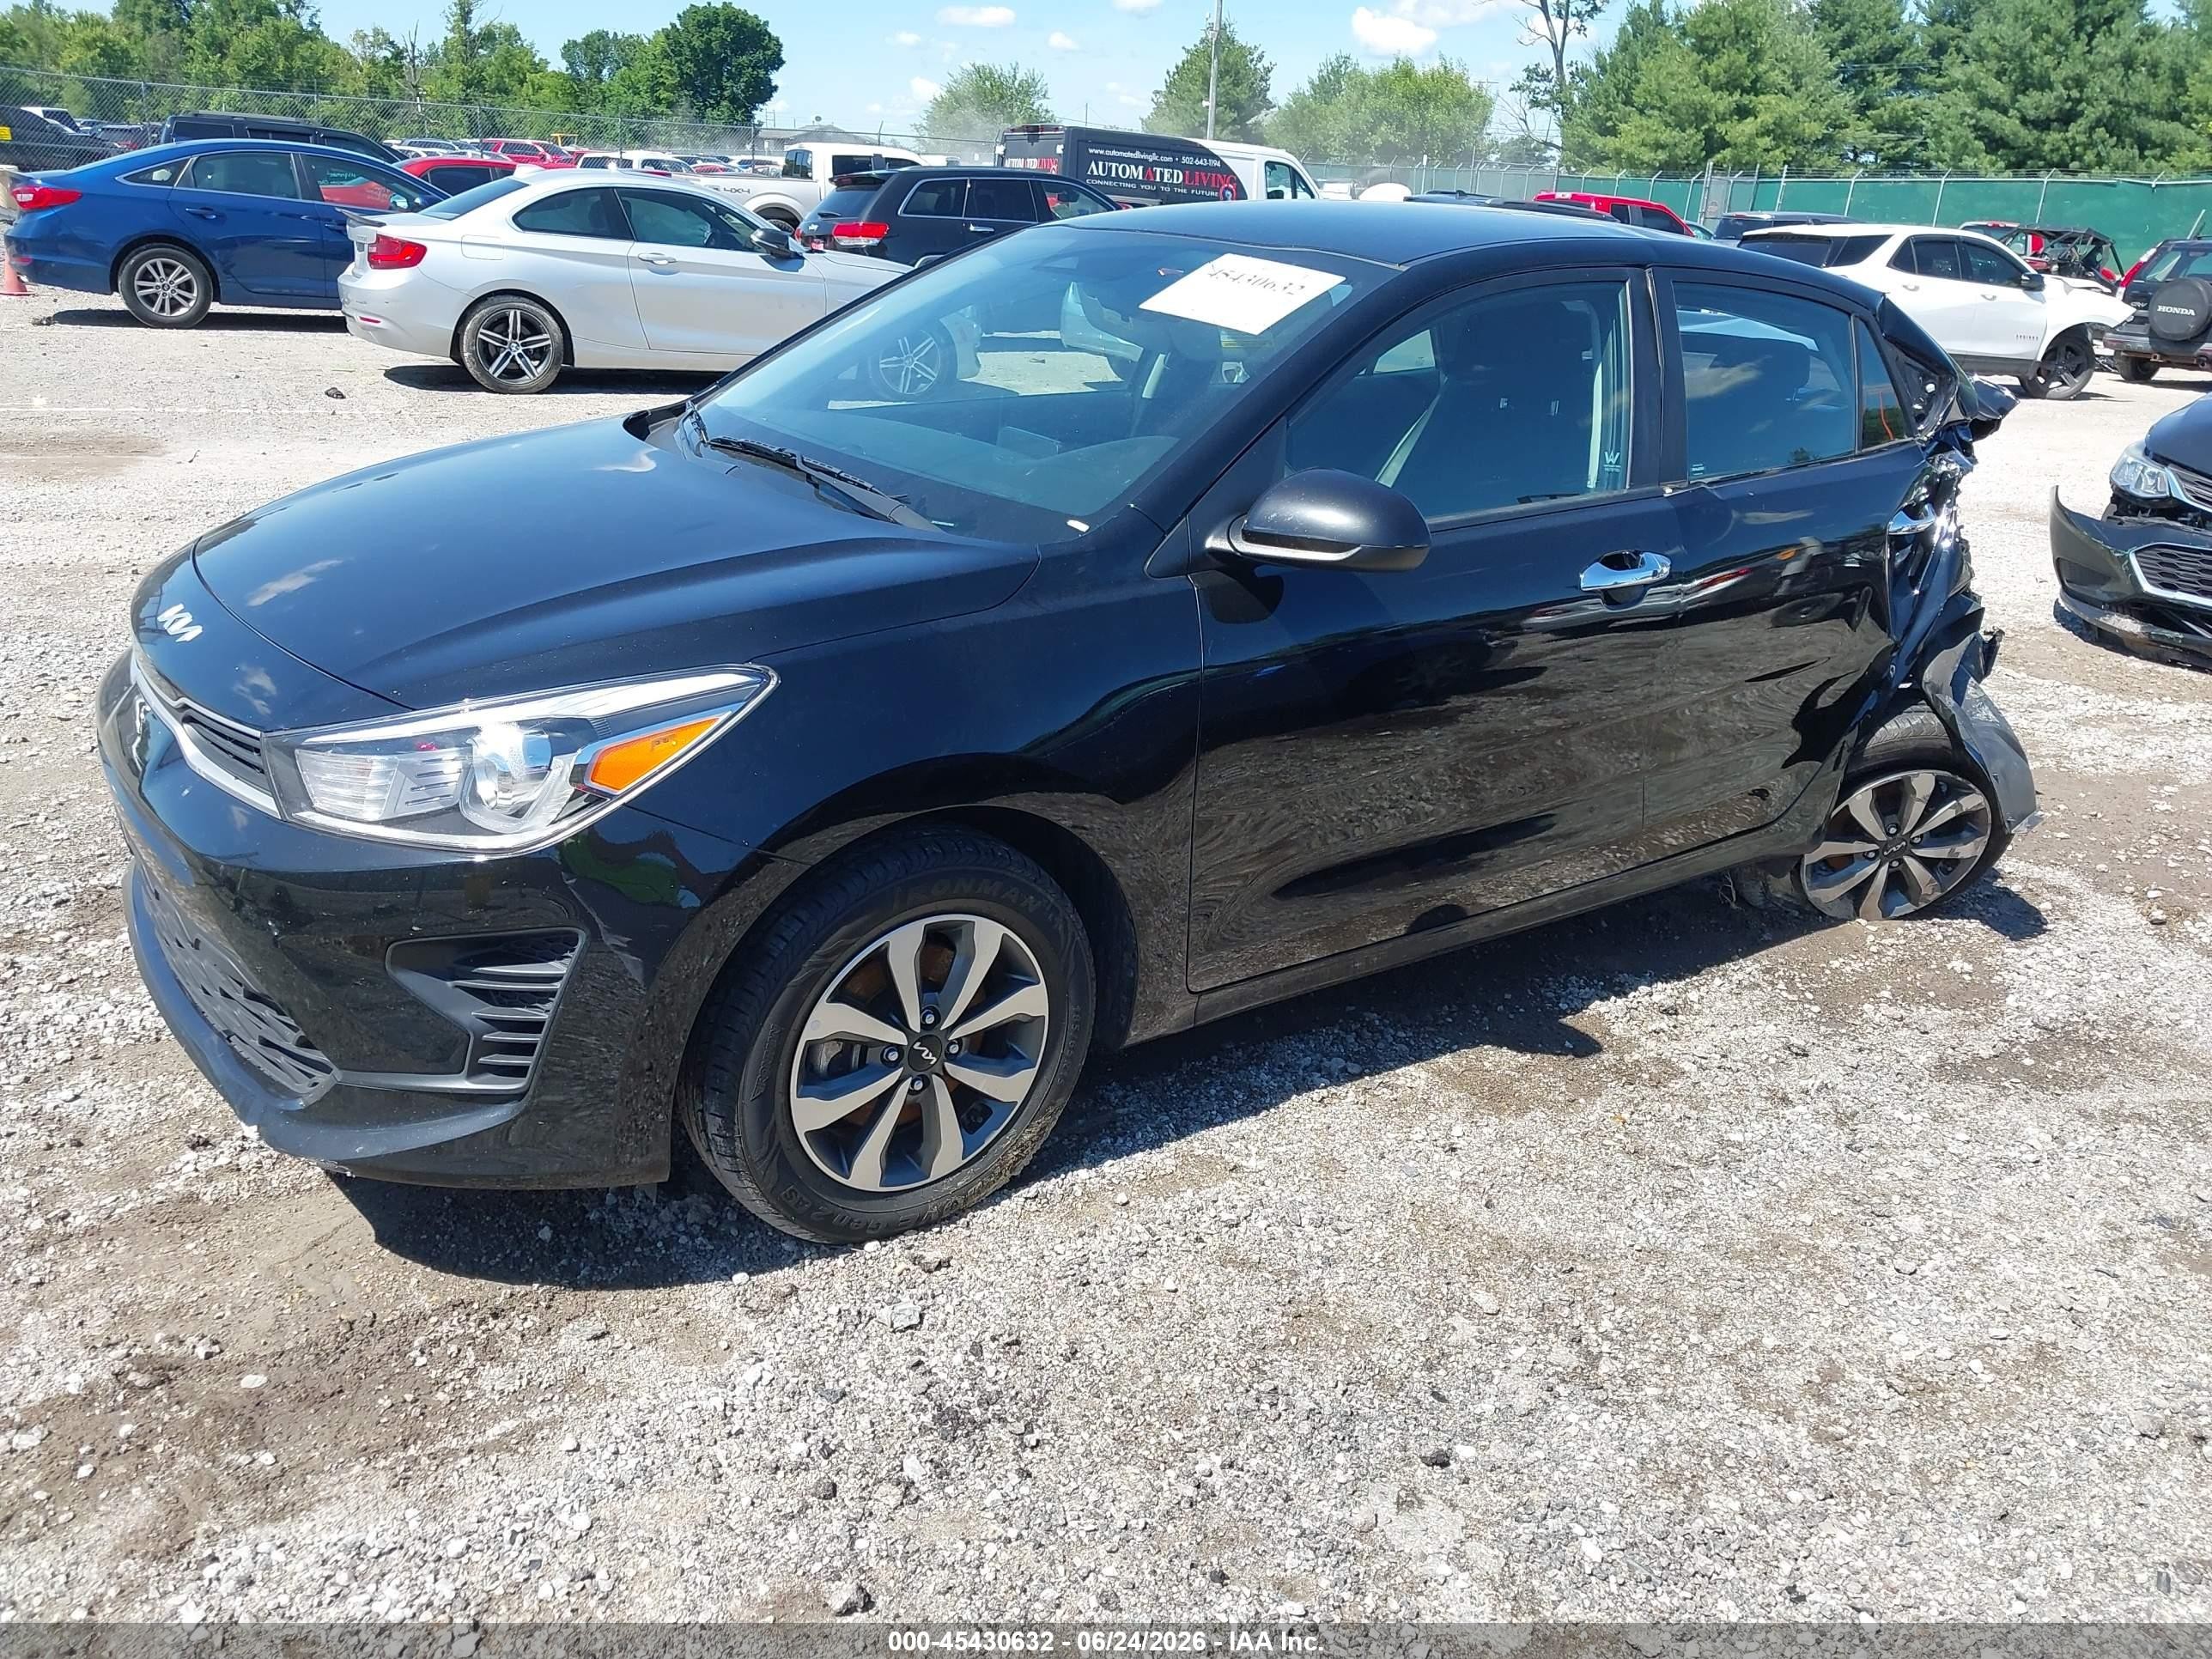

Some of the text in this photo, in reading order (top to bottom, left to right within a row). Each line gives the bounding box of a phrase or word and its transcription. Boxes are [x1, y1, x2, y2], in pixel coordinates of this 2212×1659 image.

[1088, 148, 1221, 167] www.automatedlivingllc.com 502-643-1194
[1086, 161, 1237, 188] AUTOMATED LIVING
[1085, 179, 1137, 189] CONNECTING
[1191, 189, 1219, 198] FUTURE
[2156, 305, 2197, 316] HONDA
